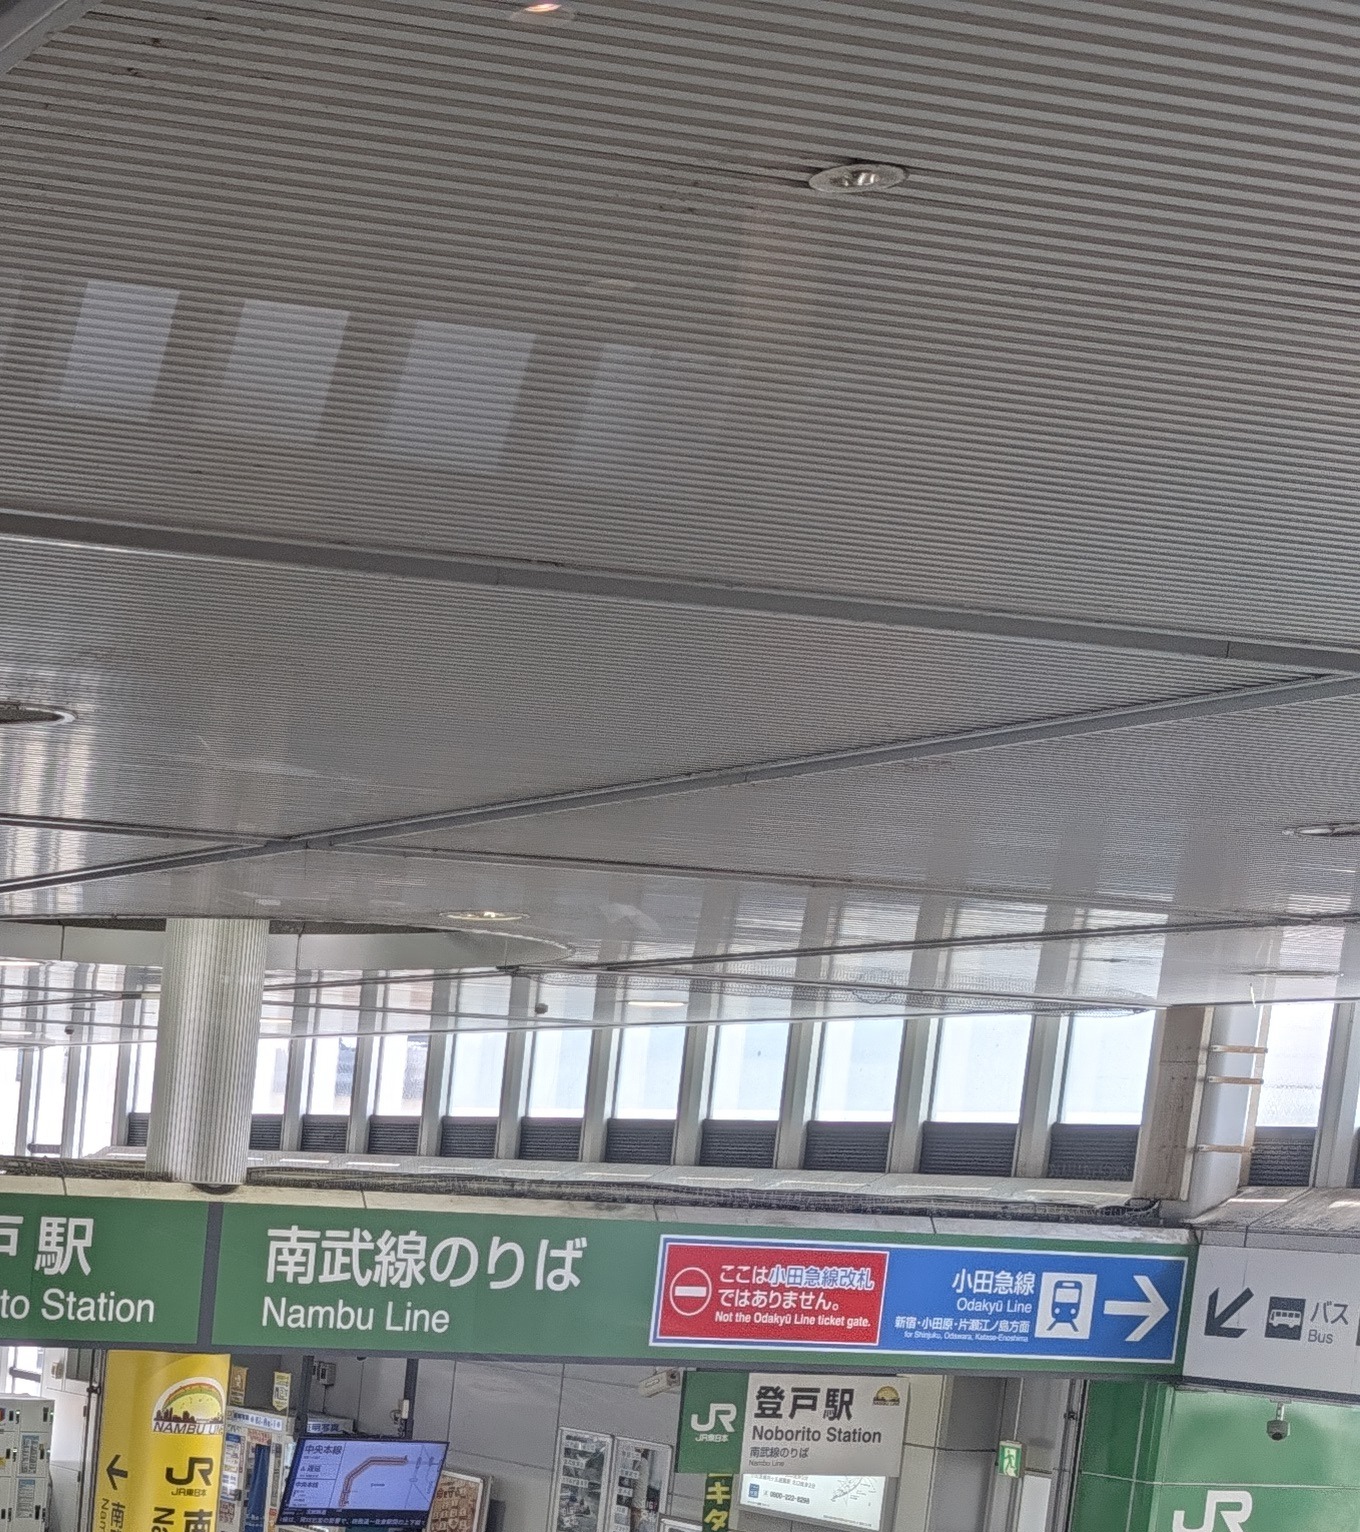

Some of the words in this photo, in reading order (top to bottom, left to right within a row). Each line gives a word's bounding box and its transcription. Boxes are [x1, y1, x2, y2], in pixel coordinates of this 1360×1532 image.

[266, 1225, 588, 1291] 南武線のりば
[720, 1264, 874, 1291] ここは小田急線改札
[952, 1268, 1036, 1296] 小田急線
[41, 1288, 155, 1323] Station
[718, 1289, 839, 1311] ではありません。
[956, 1298, 1002, 1315] Odakyū
[1007, 1300, 1032, 1313] Line
[261, 1297, 375, 1331] Nambu
[386, 1301, 451, 1334] Line
[715, 1311, 733, 1323] Not
[735, 1312, 750, 1323] the
[753, 1312, 791, 1327] Odakyū
[794, 1314, 815, 1325] Line
[817, 1314, 844, 1326] ticket
[846, 1317, 870, 1329] gate.
[1310, 1301, 1349, 1325] バス
[1308, 1329, 1333, 1344] Bus
[754, 1385, 855, 1421] 登戸駅
[153, 1421, 204, 1435] NAMBU
[690, 1403, 737, 1432] JR
[751, 1425, 821, 1443] Noborito
[826, 1427, 881, 1444] Station
[305, 1445, 342, 1455] 中央本線
[749, 1447, 809, 1459] 南武線のりば
[165, 1457, 213, 1486] JR
